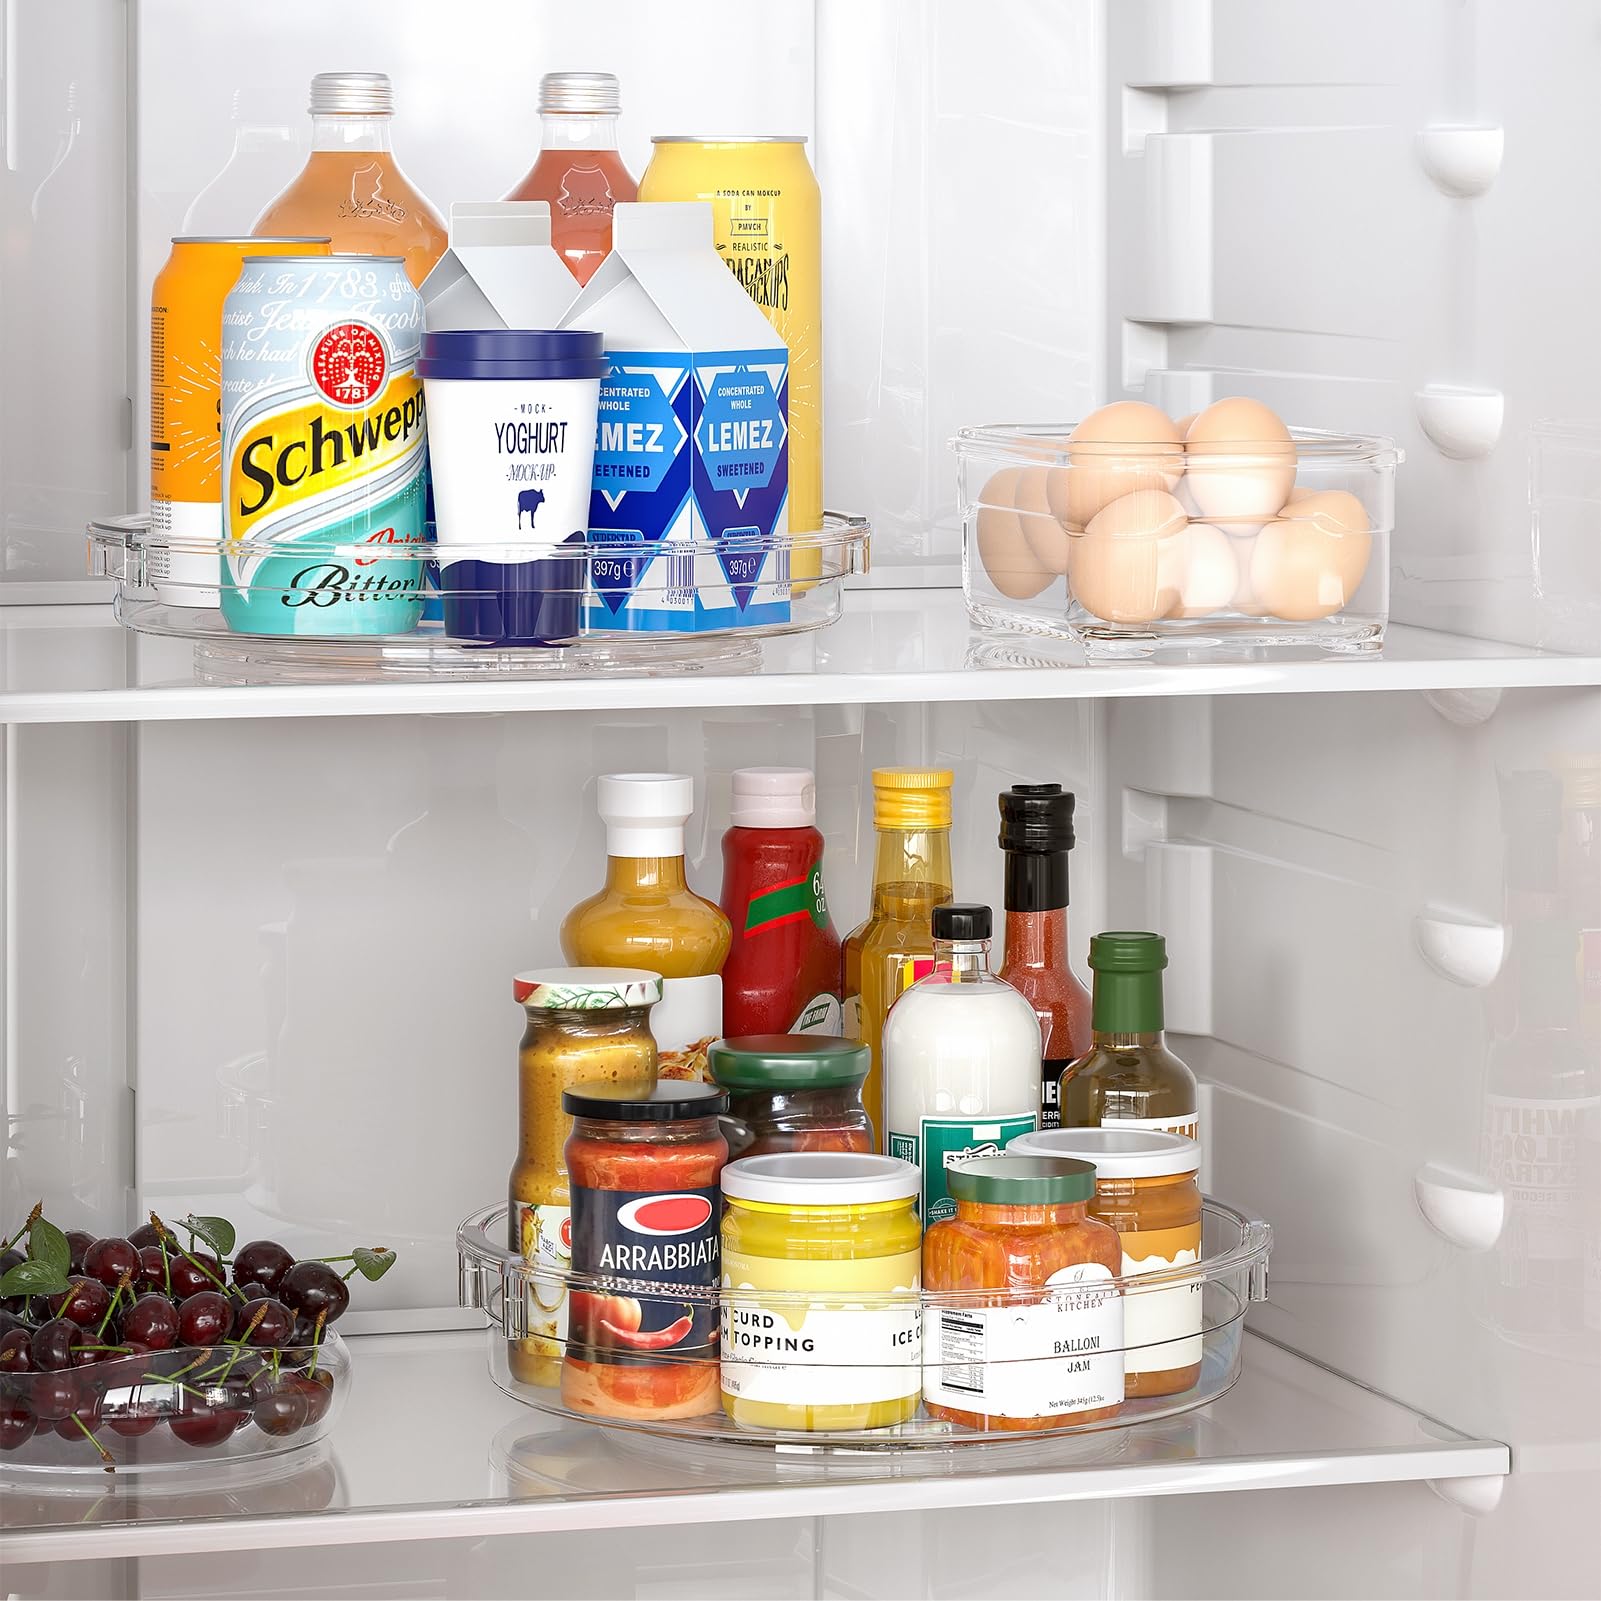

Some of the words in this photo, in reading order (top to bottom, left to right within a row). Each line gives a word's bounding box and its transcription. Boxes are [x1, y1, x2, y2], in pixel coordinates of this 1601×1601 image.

[738, 223, 761, 231] PMVCH
[732, 242, 768, 251] REALISTIC
[335, 388, 369, 400] 1783
[717, 385, 765, 398] CONCENTRATED
[730, 400, 752, 410] WHOLE
[494, 421, 568, 454] YOGHURT
[708, 419, 773, 453] LEMEZ
[717, 461, 765, 477] SWEETENED
[594, 560, 621, 580] 397g
[729, 560, 747, 578] 397g
[600, 1235, 719, 1271] ARRABBIATA
[1057, 1297, 1103, 1313] KITCHEN
[734, 1309, 774, 1329] CURD
[733, 1330, 814, 1352] TOPPING
[893, 1329, 913, 1347] ICE
[1053, 1336, 1100, 1354] BALLONI
[1067, 1360, 1091, 1374] JAM
